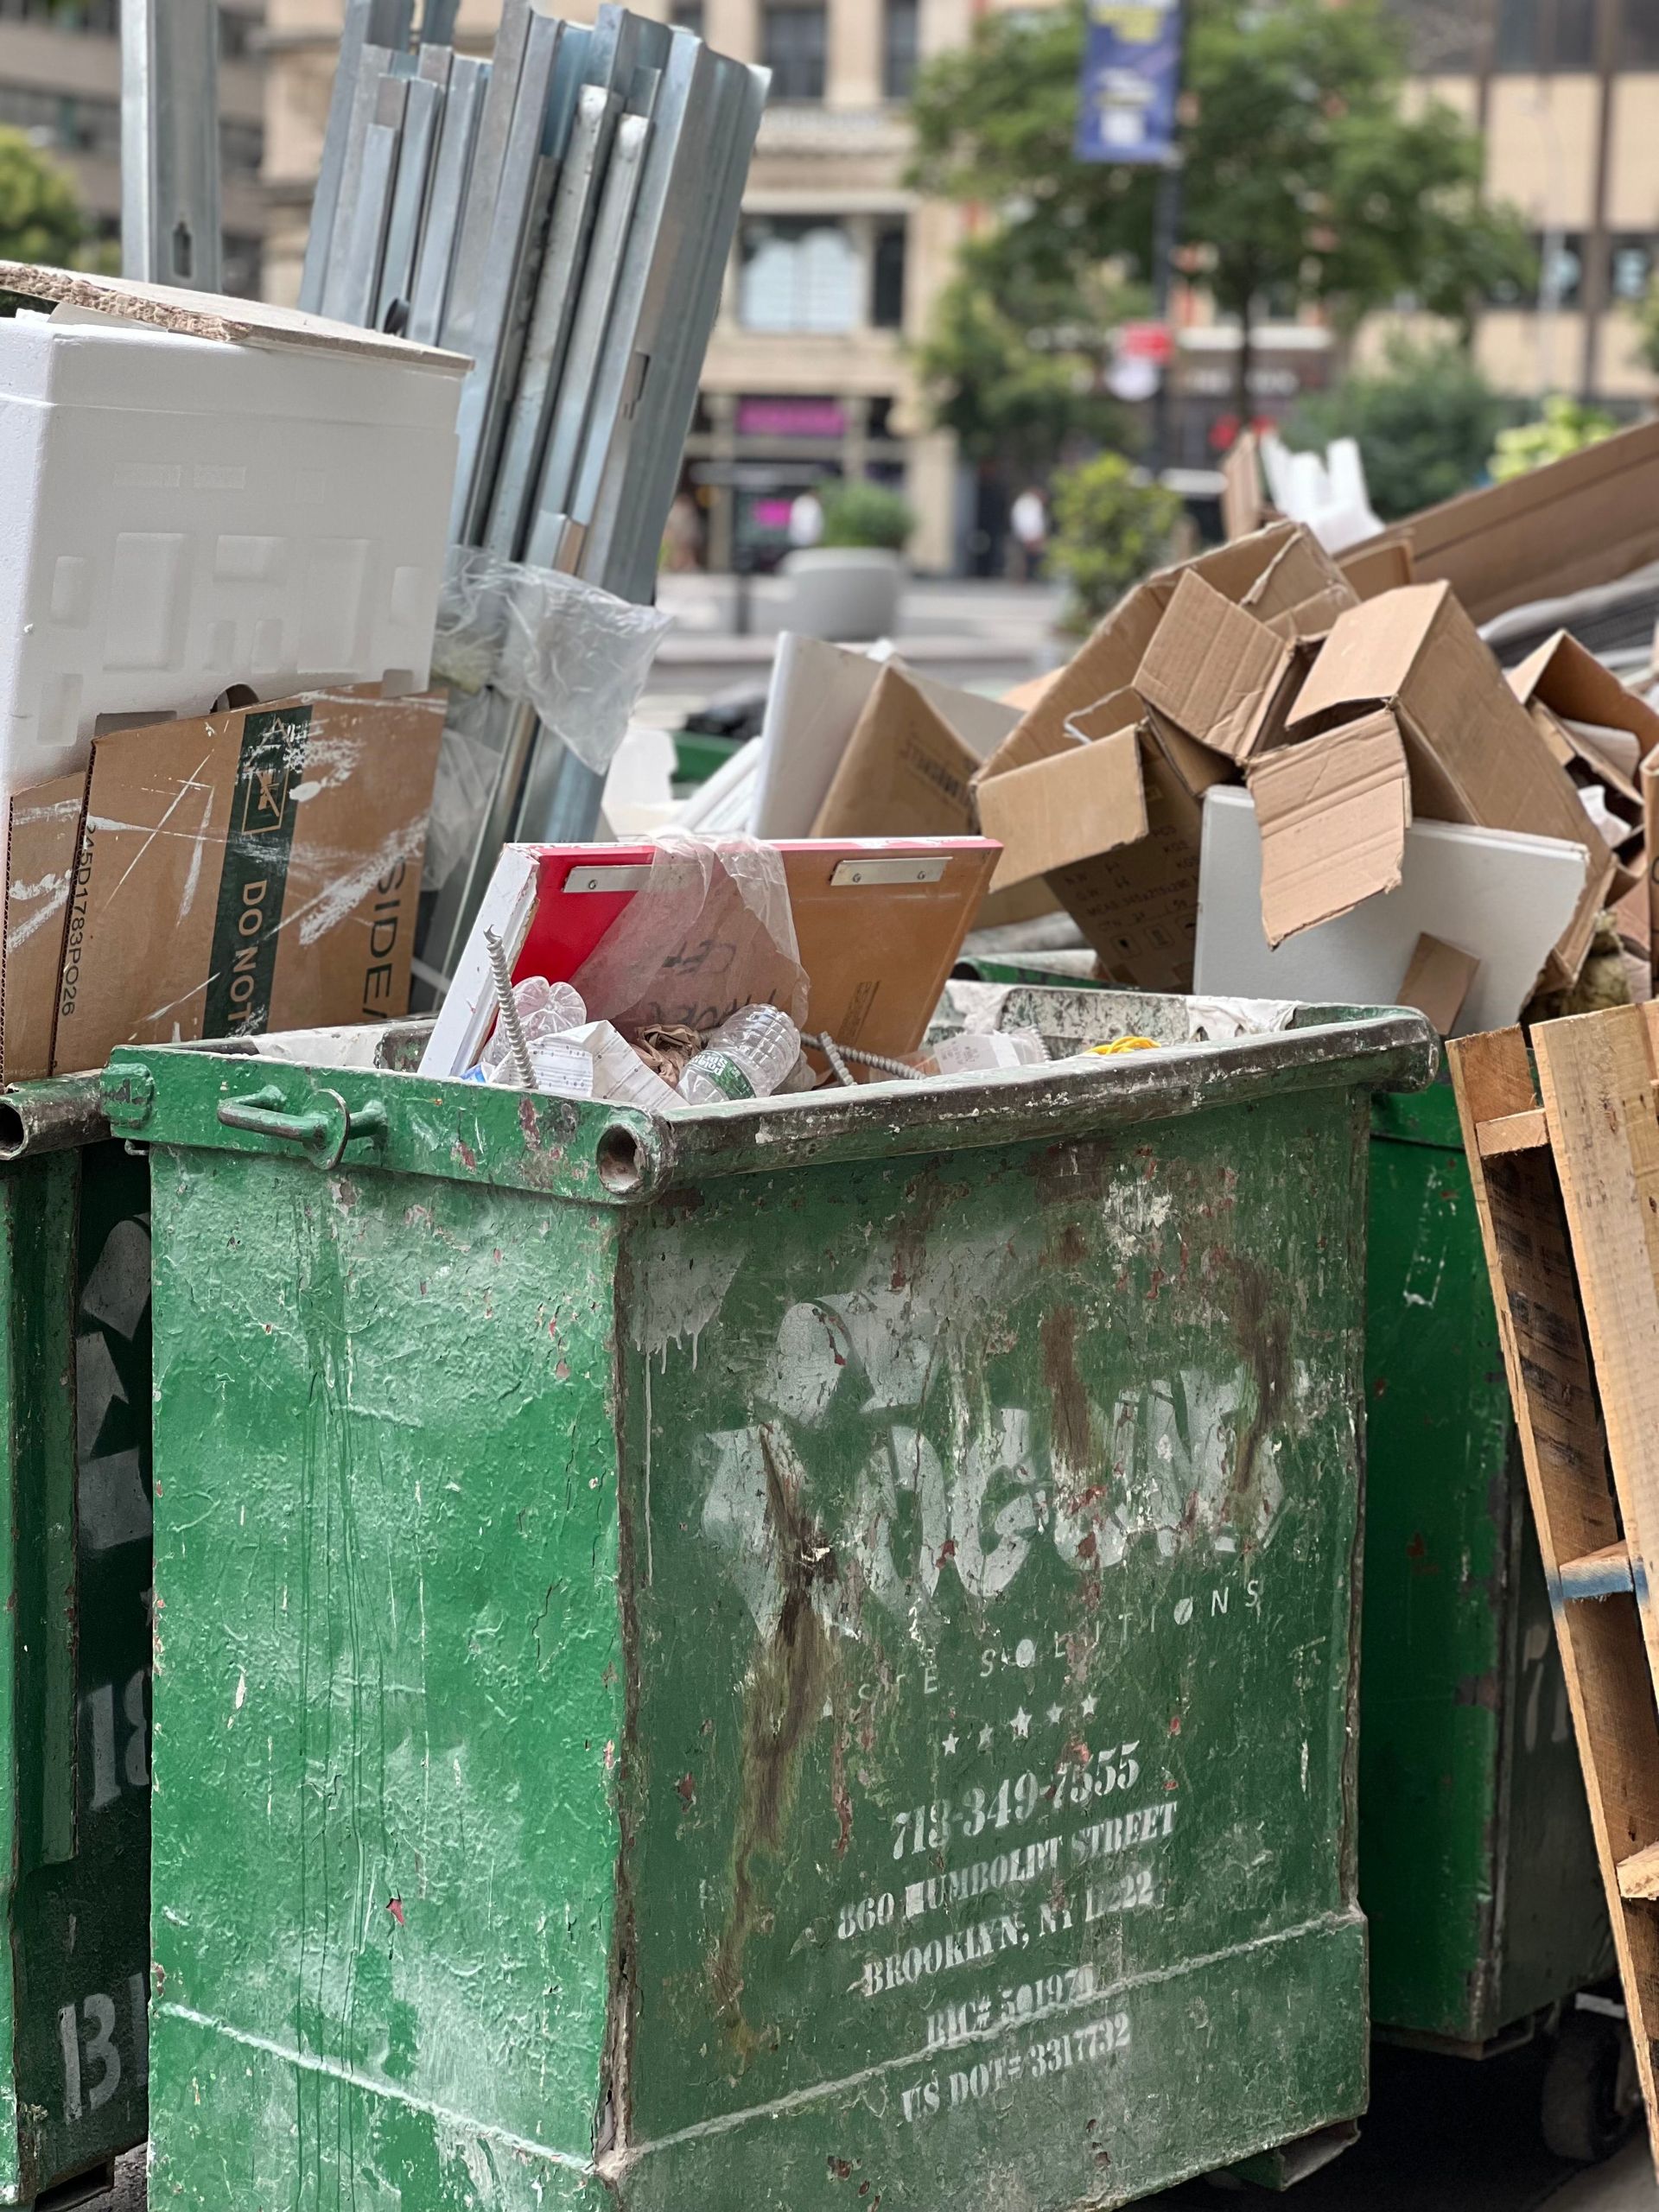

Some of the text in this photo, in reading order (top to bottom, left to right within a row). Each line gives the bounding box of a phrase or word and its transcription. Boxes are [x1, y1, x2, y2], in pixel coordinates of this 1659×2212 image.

[227, 880, 267, 1021] DO NOT
[837, 1801, 1178, 1941] 860 HUMBOLDT STREET
[901, 2081, 941, 2123] US
[1028, 2010, 1132, 2078] 3317732
